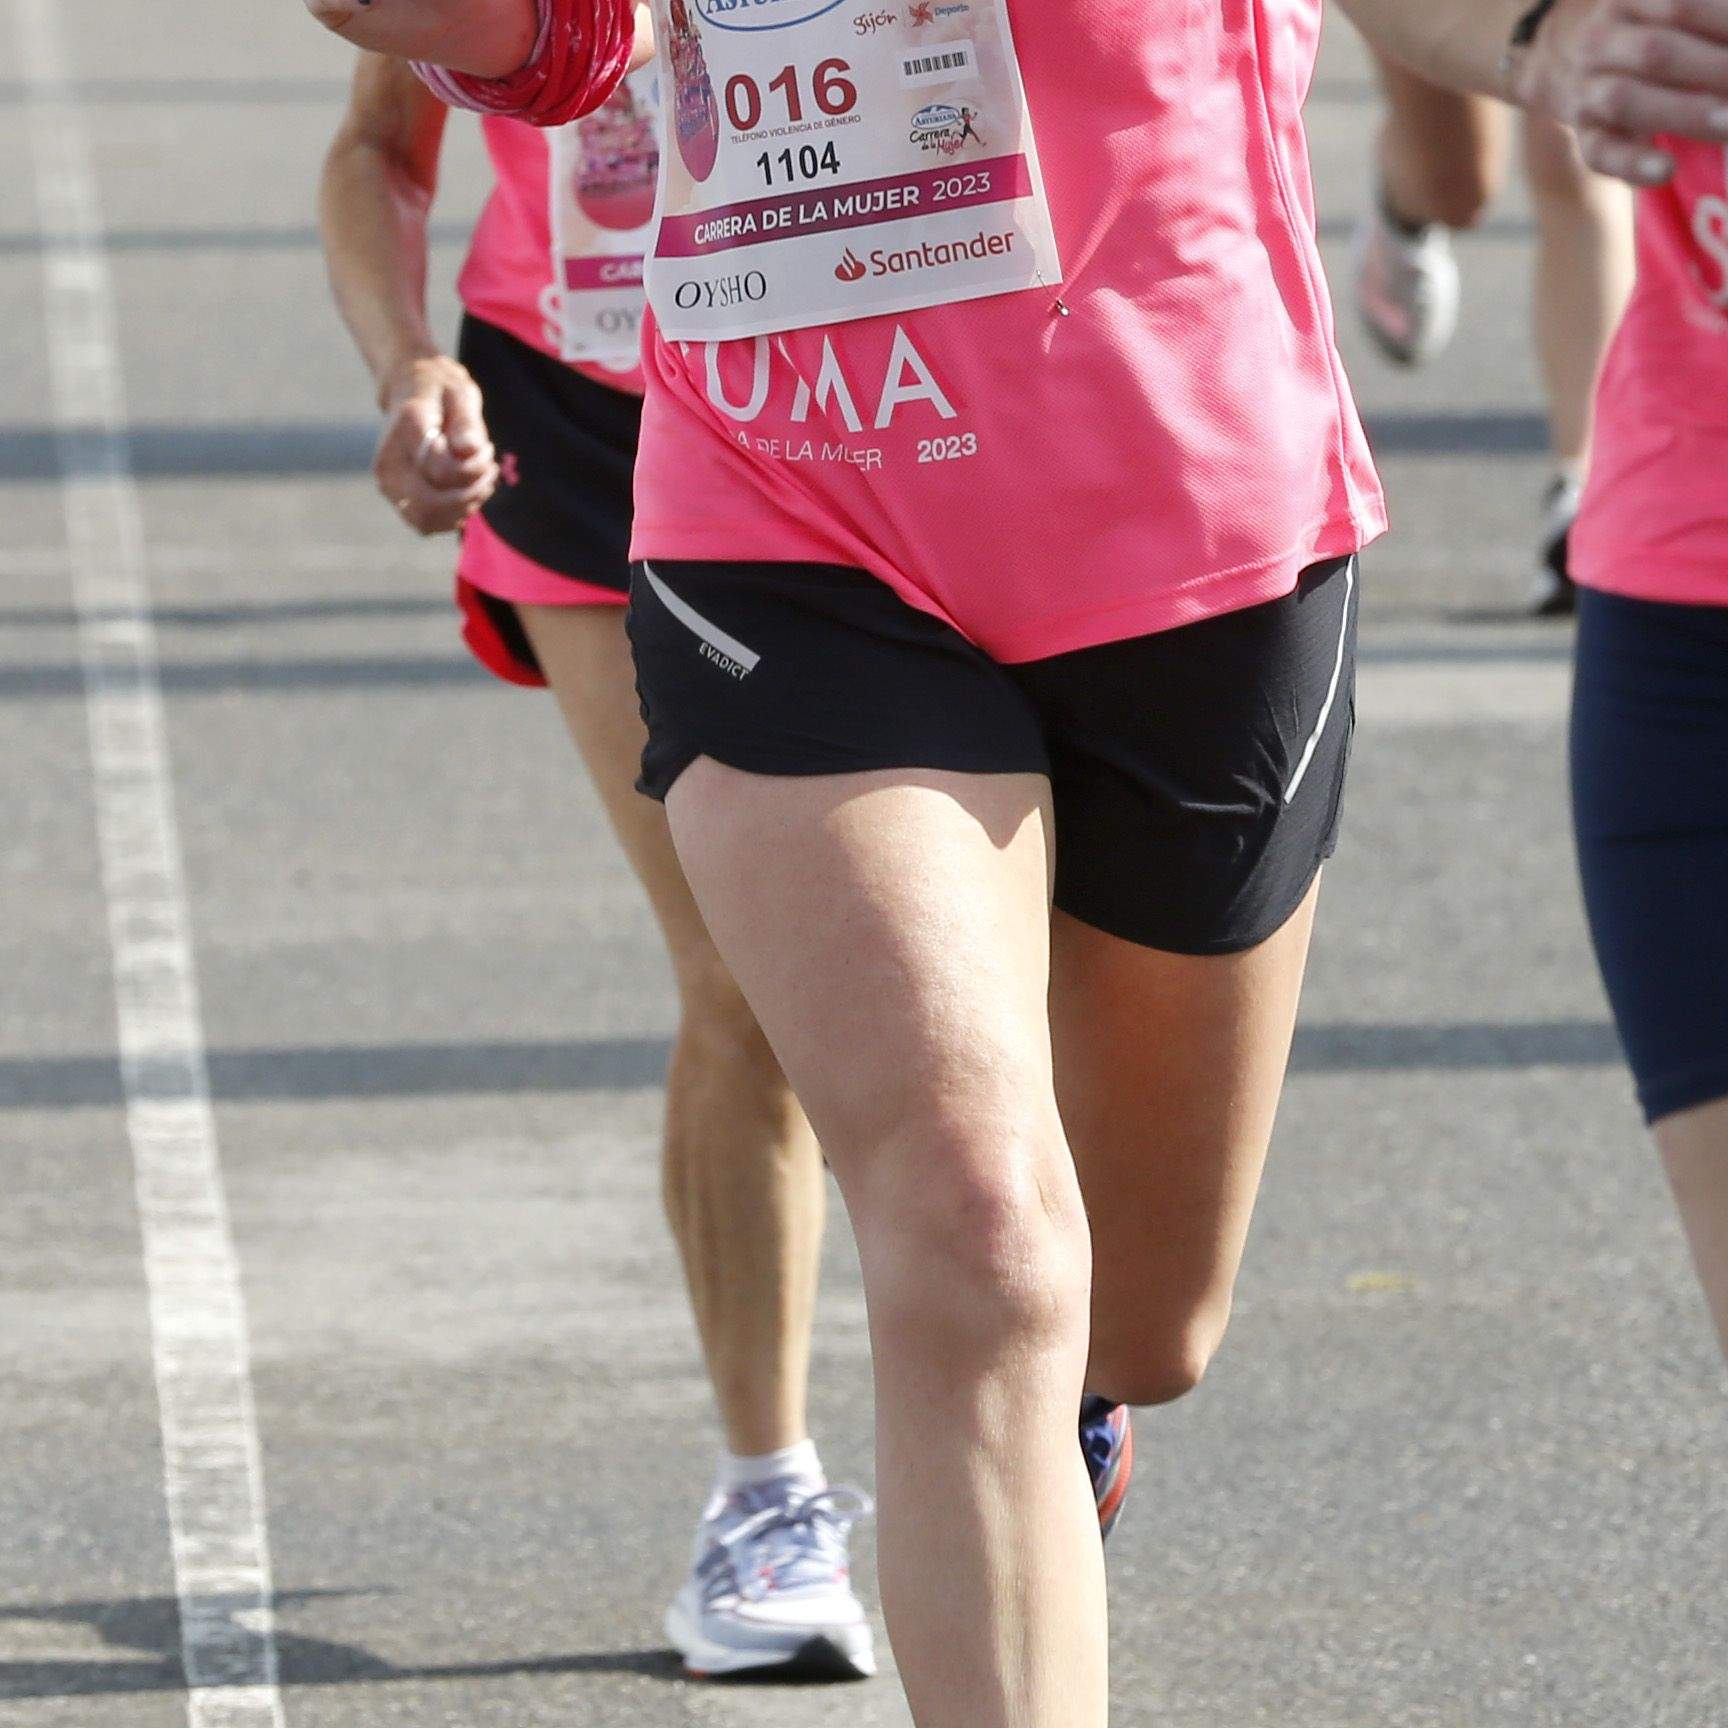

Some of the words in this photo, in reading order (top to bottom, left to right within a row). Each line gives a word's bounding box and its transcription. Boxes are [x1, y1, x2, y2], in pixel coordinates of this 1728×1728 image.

[725, 58, 858, 131] 016
[731, 129, 768, 144] TELÉFONO
[769, 122, 813, 138] VIOLENCIA
[814, 120, 824, 131] DE
[825, 114, 862, 129] GÉNERO
[757, 140, 841, 186] 1104
[694, 214, 758, 246] CARRERA
[761, 207, 793, 231] DE
[798, 202, 829, 225] LA
[833, 185, 921, 219] MUJER
[932, 171, 992, 202] 2023
[870, 230, 1015, 277] Santander
[674, 270, 768, 310] OYSHO
[679, 324, 958, 433] UMA
[756, 437, 781, 460] DE
[785, 439, 814, 462] LA
[821, 443, 883, 472] MUER
[917, 432, 979, 464] 2023
[698, 641, 750, 681] EVADICT
